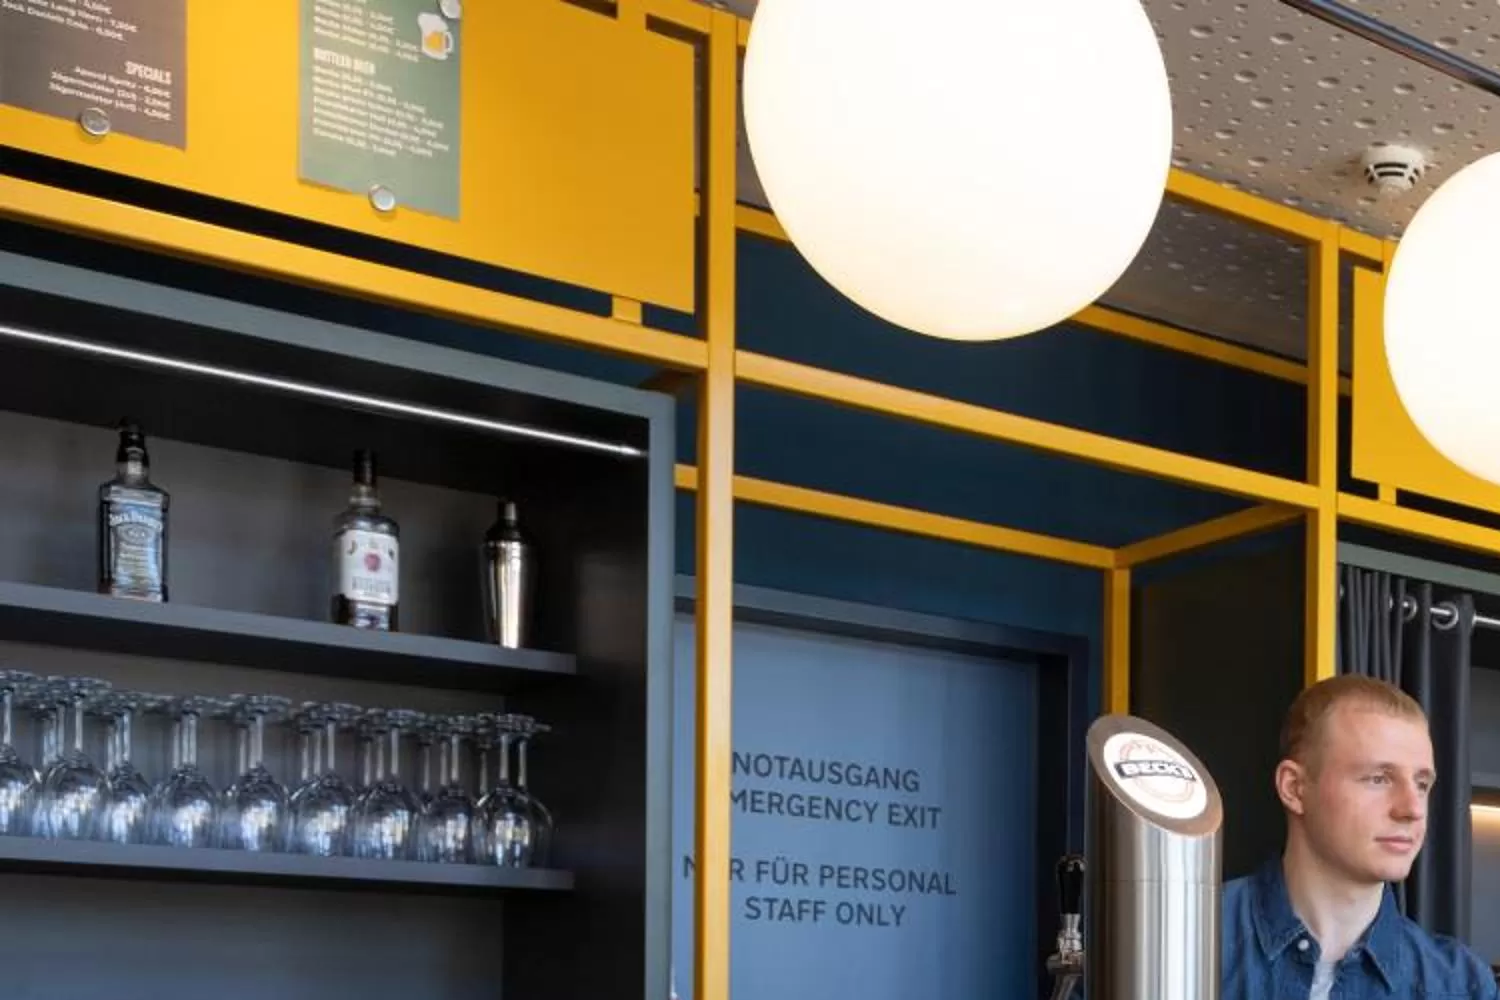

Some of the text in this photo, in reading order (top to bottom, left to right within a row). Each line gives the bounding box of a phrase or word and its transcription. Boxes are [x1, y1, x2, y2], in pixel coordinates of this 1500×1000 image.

[124, 60, 172, 85] SPECIALS
[732, 751, 920, 793] NOTAUSGANG
[730, 788, 942, 829] MERGENCY EXIT
[683, 855, 956, 896] NR FÜR PERSONAL
[744, 896, 906, 927] STAFF ONLY
